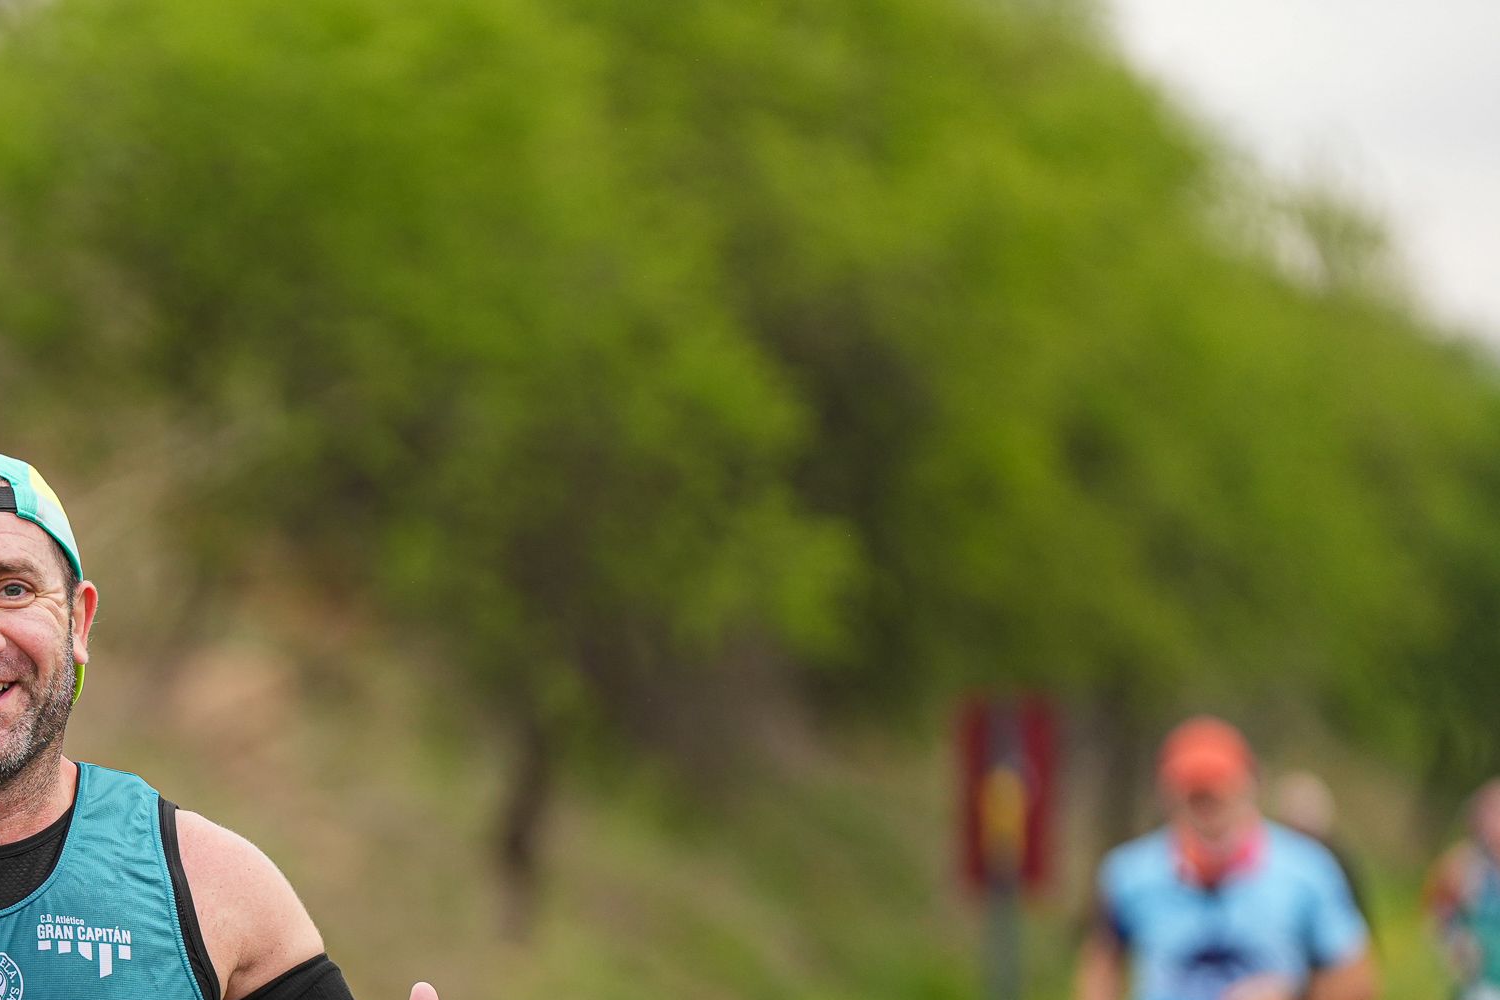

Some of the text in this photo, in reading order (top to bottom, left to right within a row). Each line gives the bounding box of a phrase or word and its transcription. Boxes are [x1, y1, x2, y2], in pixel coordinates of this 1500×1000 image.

[56, 914, 84, 925] Atlético
[37, 924, 131, 944] GRAN CAPITÁN
